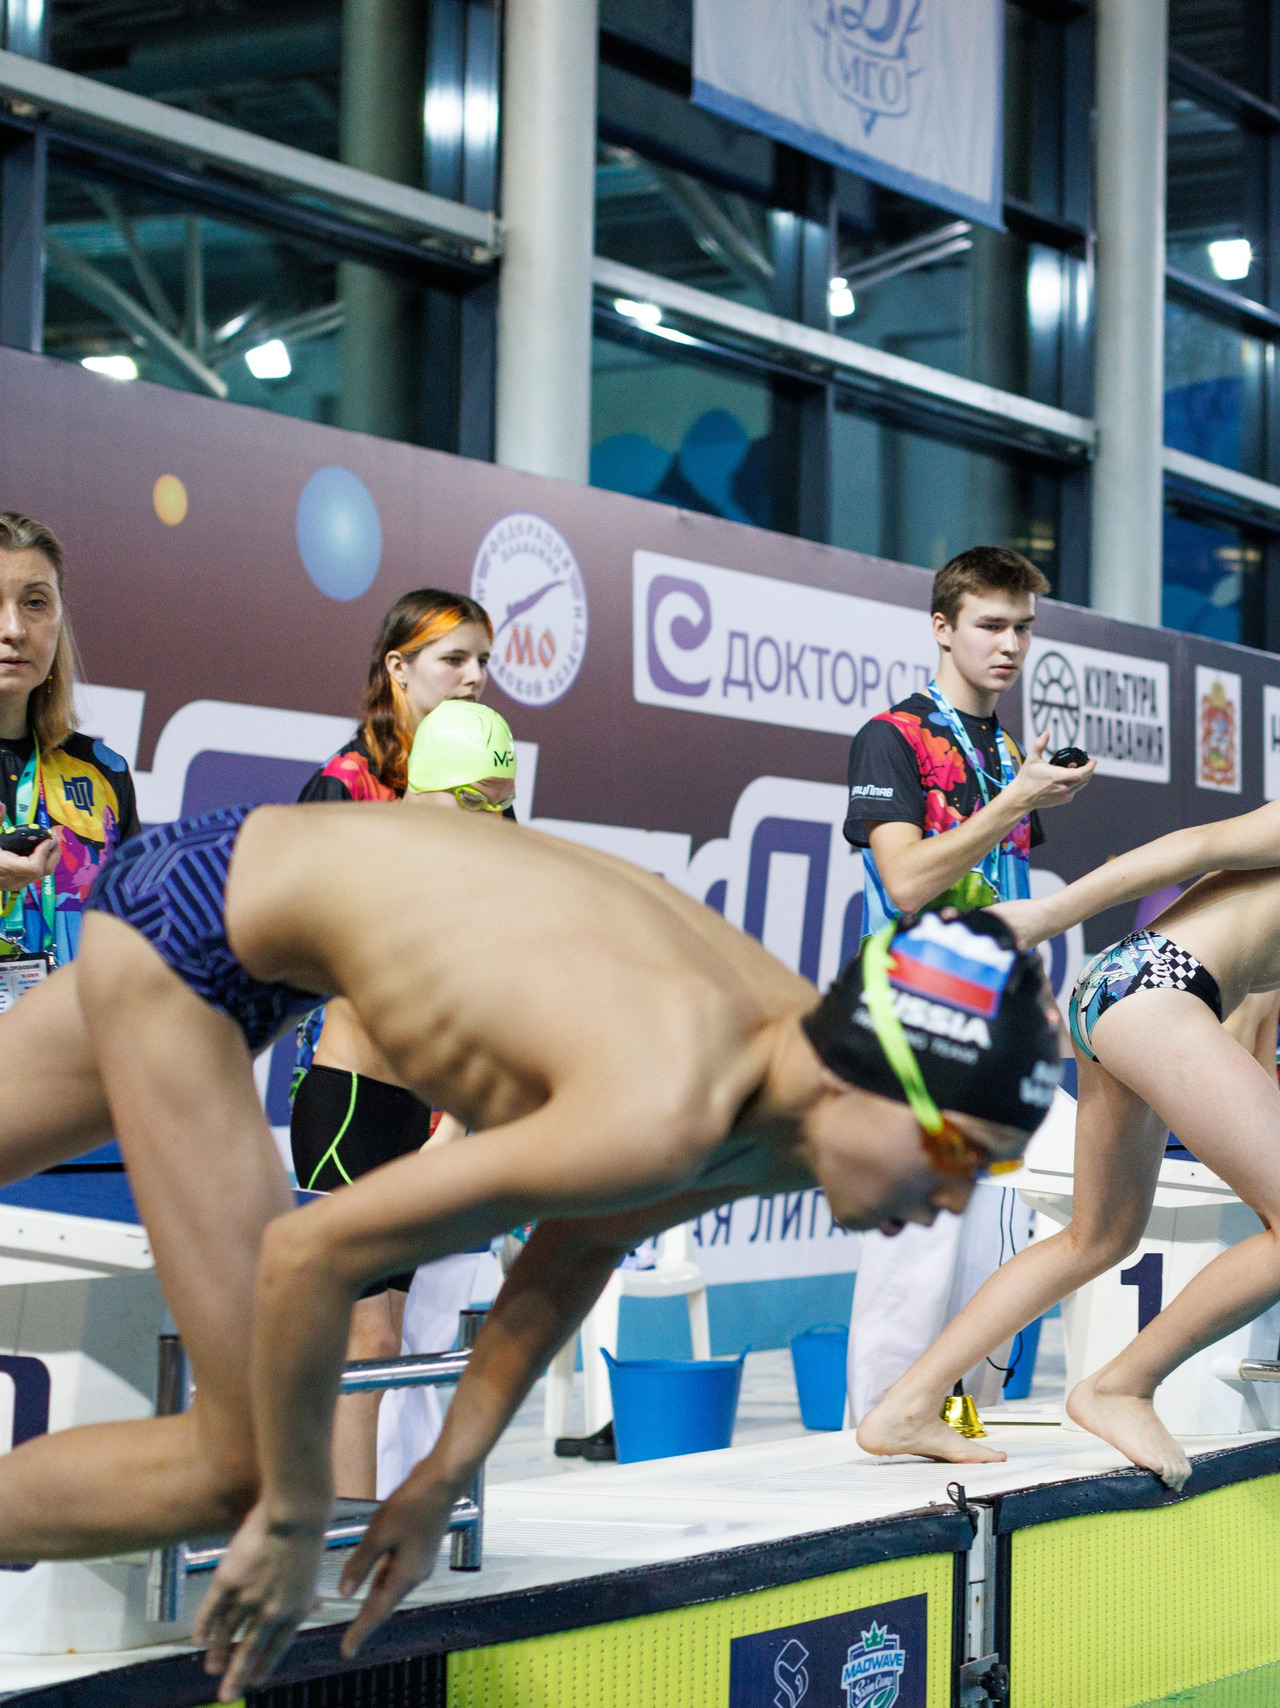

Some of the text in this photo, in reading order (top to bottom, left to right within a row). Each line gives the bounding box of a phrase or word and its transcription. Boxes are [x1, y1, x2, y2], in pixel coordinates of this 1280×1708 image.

[1084, 665, 1158, 718] КУЛЬТУРА
[1084, 712, 1165, 767] ПЛАВАНИЯ
[1120, 1252, 1164, 1334] 1
[844, 1653, 903, 1682] MADWAVE
